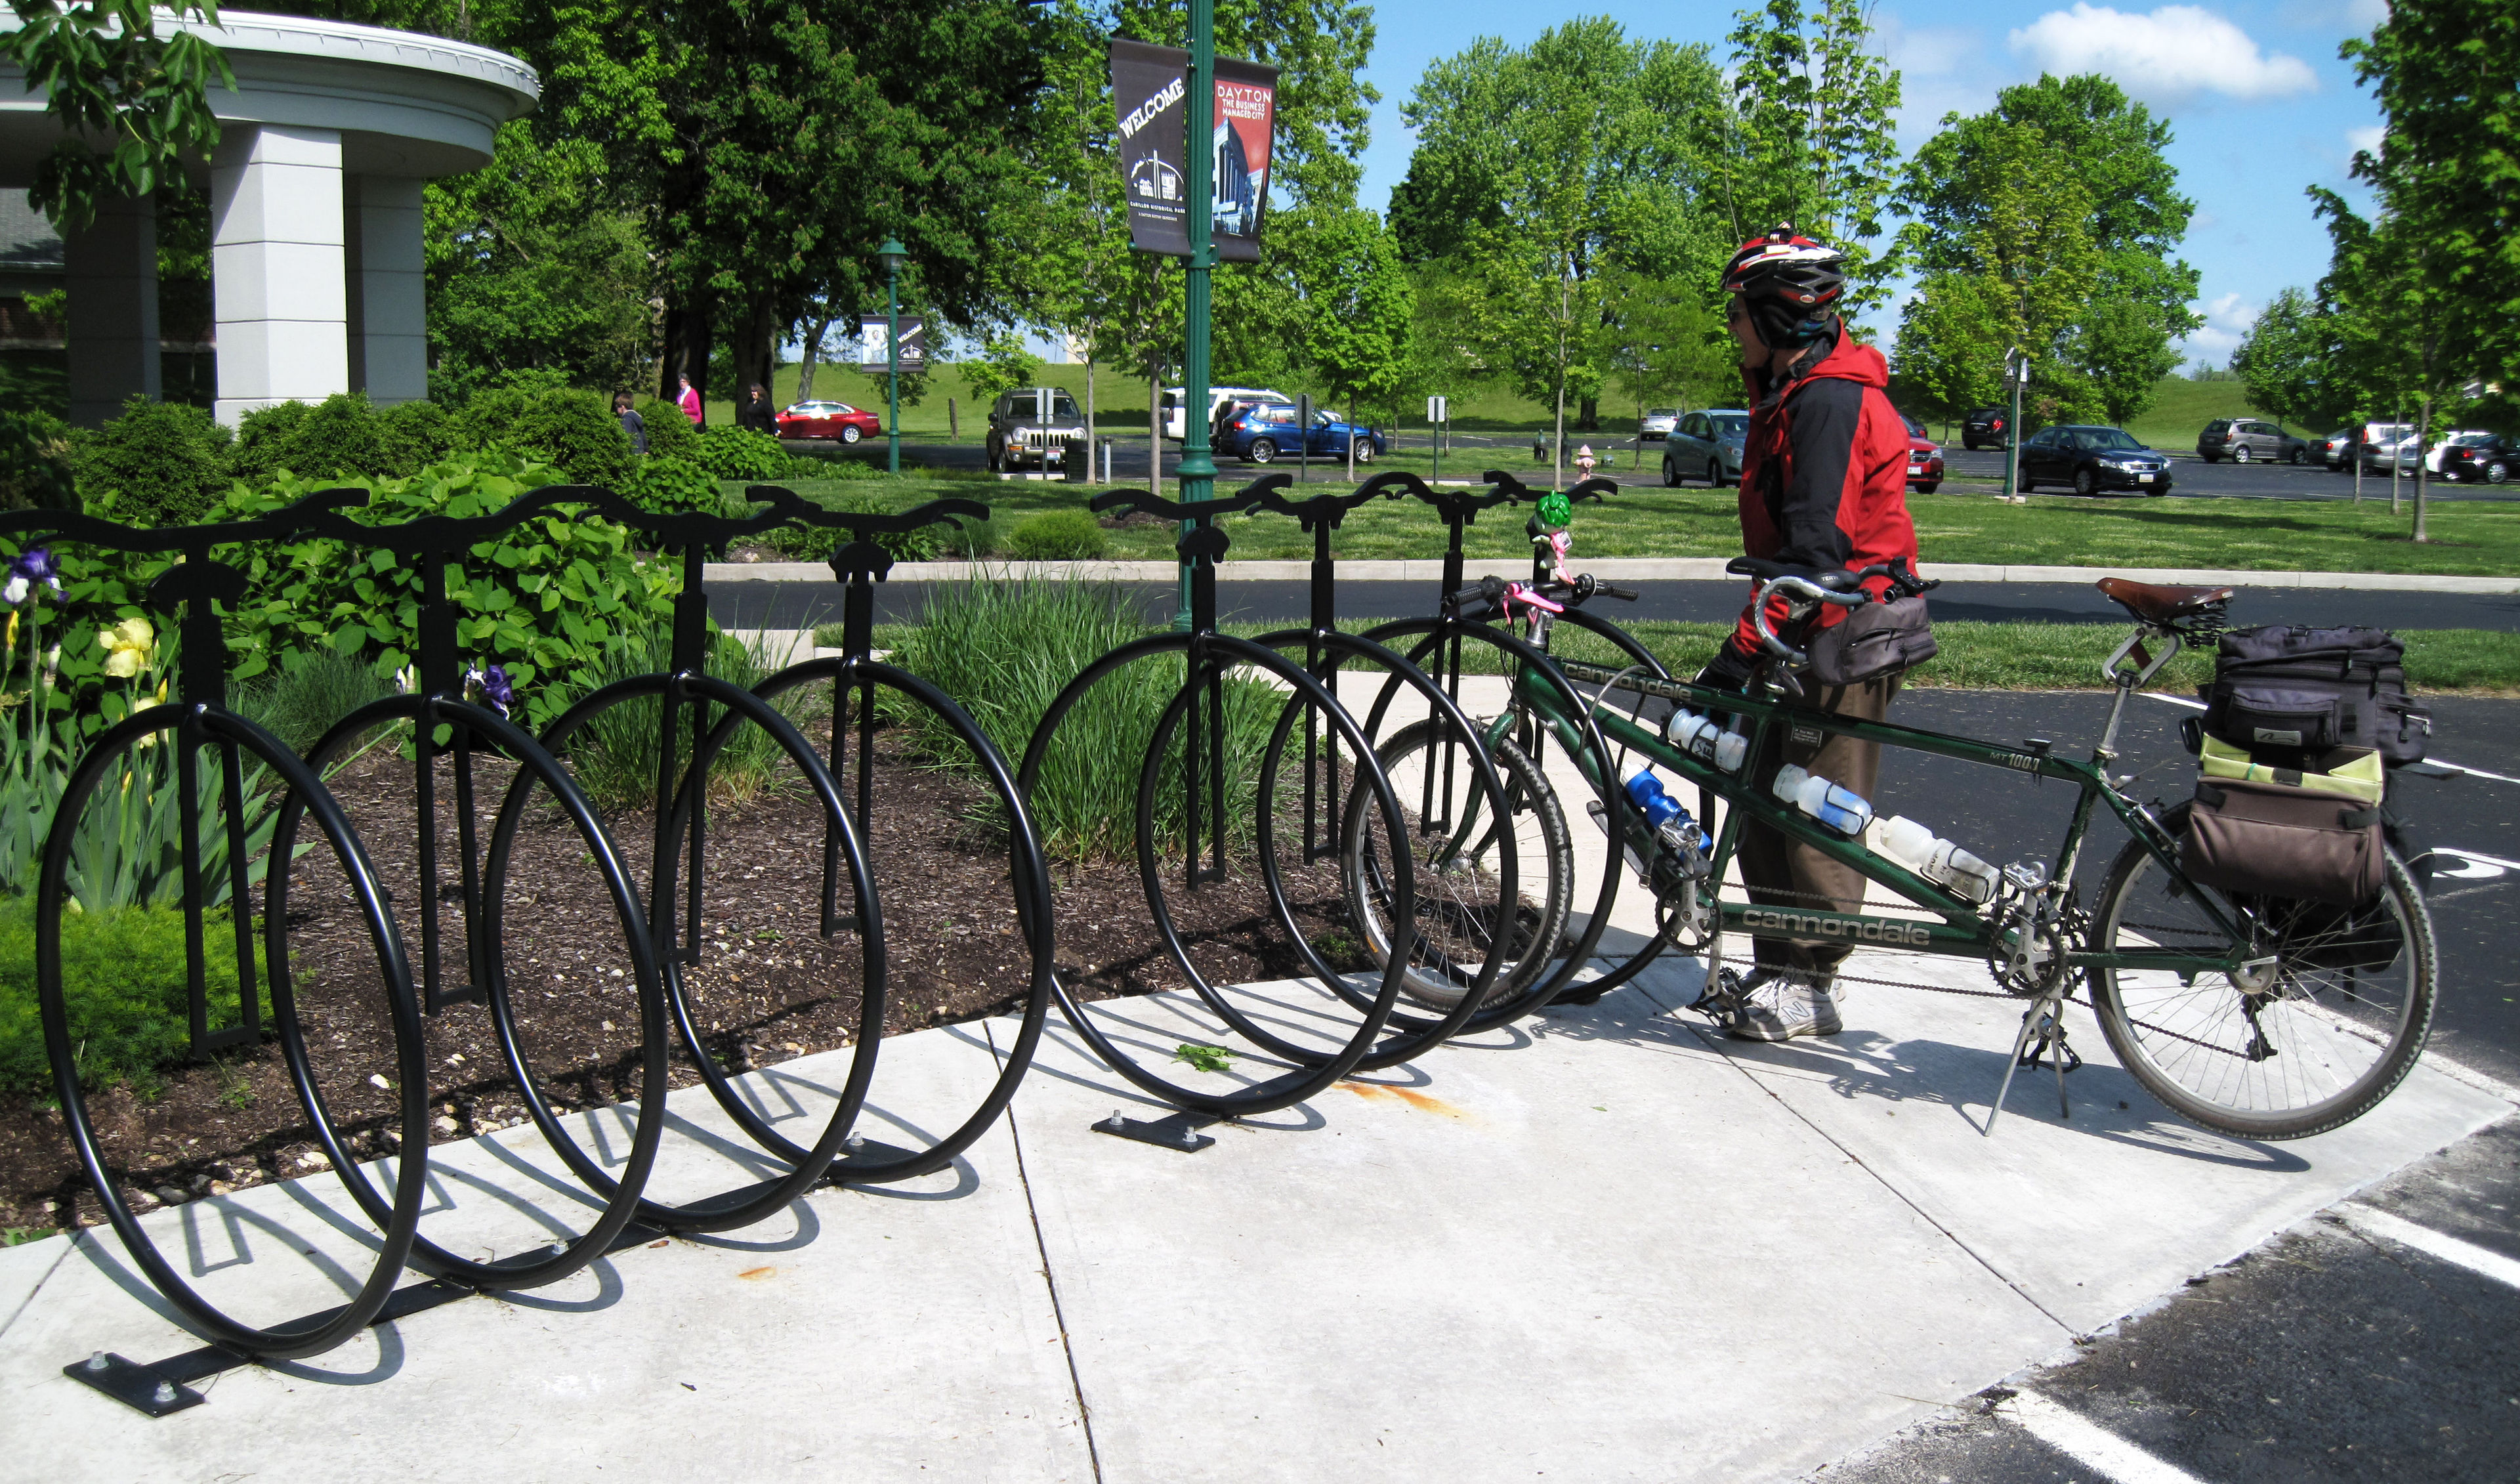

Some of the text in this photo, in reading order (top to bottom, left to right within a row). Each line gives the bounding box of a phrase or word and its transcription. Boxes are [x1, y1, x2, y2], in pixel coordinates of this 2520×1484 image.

[1217, 85, 1271, 103] DAYTON
[1119, 77, 1185, 139] WELCOME
[1222, 98, 1265, 112] THE BUSINESS
[1222, 107, 1265, 121] MANAGED CITY
[897, 323, 923, 343] WELCOME
[1564, 663, 1692, 702] cannondale
[1989, 752, 2040, 771] MT 1000
[1742, 909, 1931, 946] cannondale
